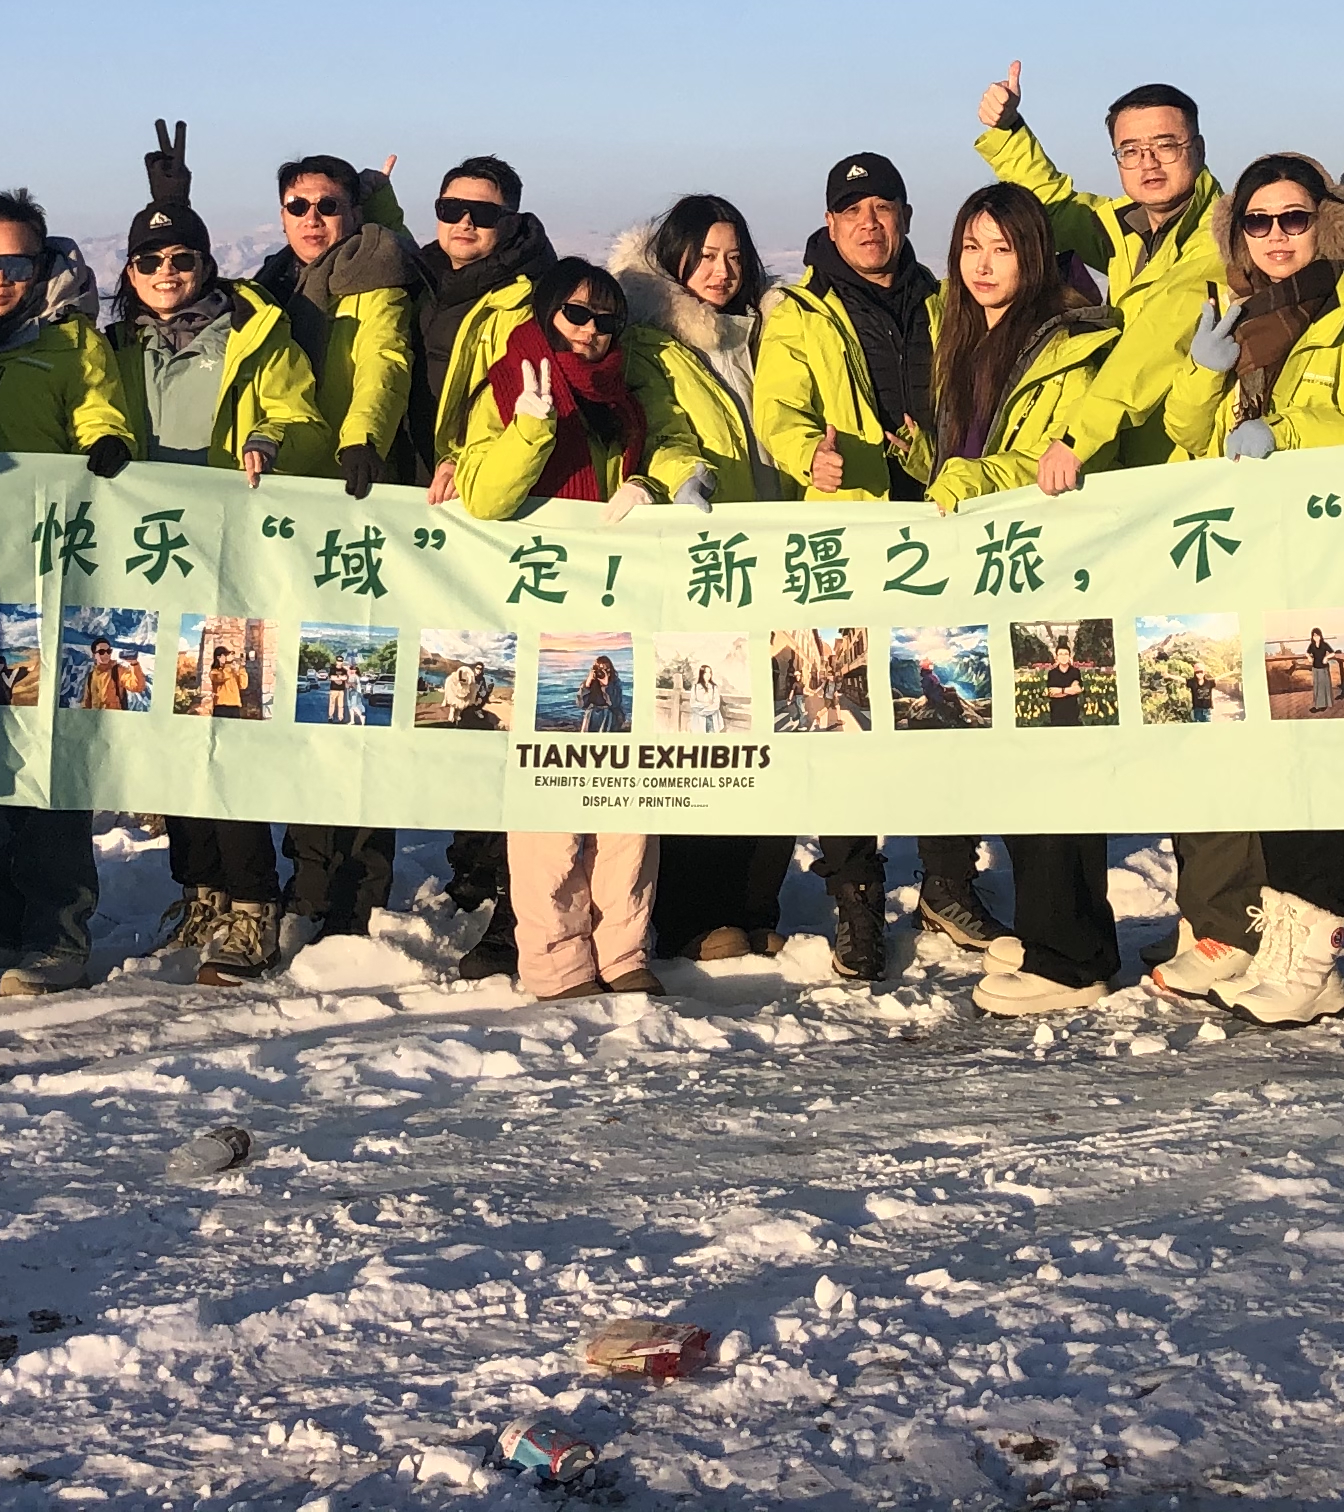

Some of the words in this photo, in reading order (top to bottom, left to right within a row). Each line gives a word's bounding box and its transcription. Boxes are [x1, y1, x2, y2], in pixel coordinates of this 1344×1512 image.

[515, 743, 631, 769] TIANYU
[637, 744, 771, 769] EXHIBITS
[718, 776, 755, 788] SPACE
